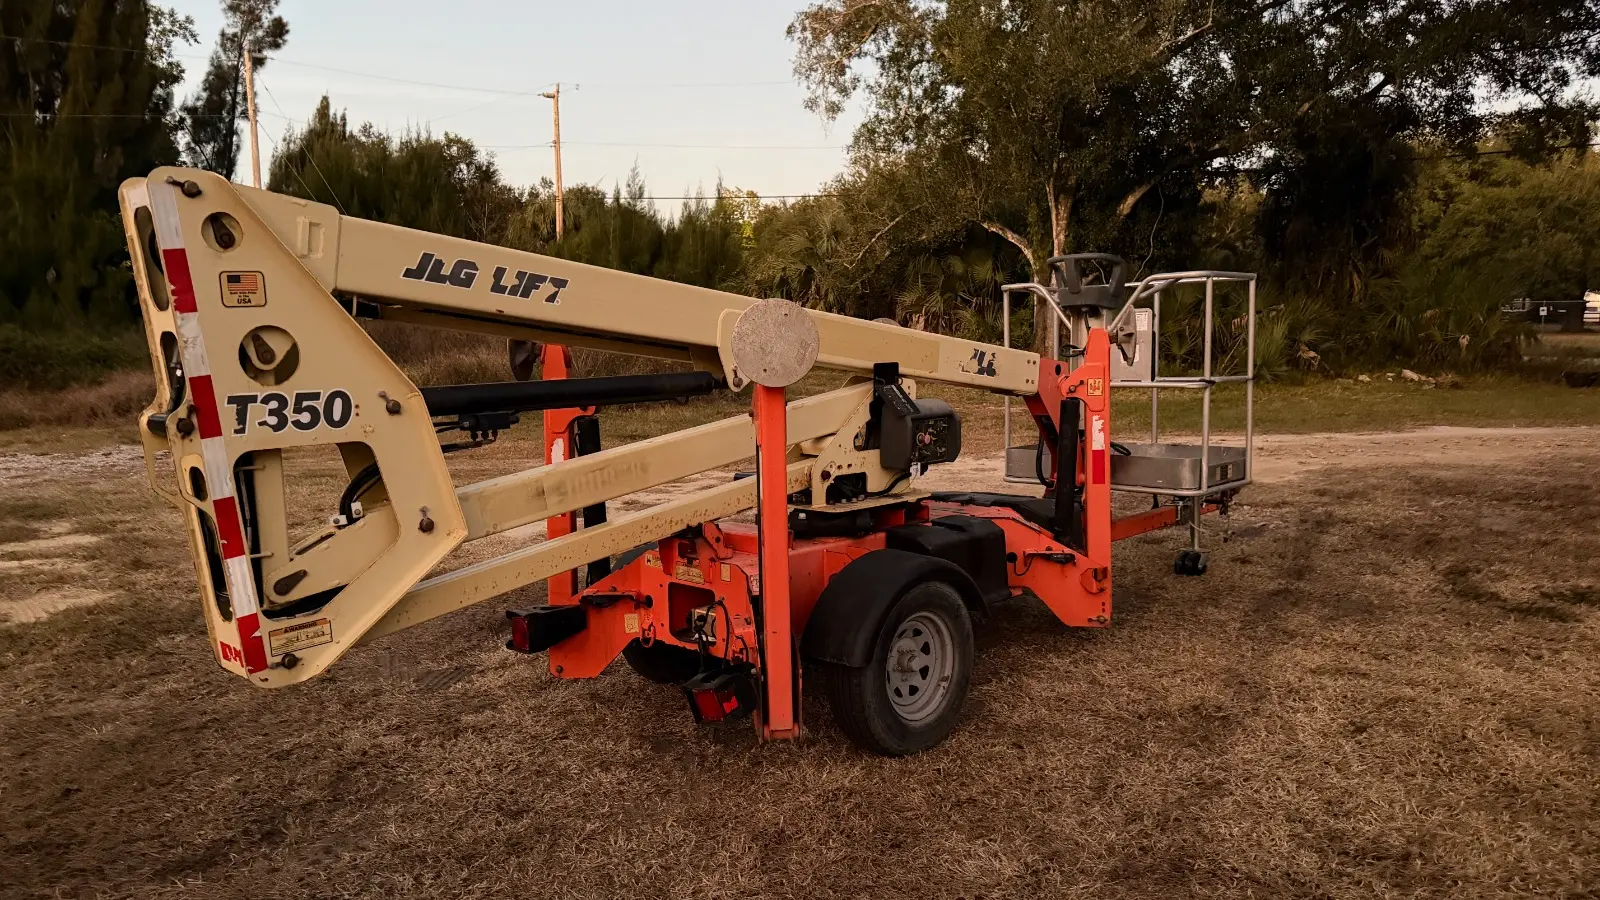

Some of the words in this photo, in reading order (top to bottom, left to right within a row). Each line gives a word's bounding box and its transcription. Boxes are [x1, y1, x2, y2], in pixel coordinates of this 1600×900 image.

[401, 251, 480, 289] JLG
[490, 266, 570, 304] LIFT
[225, 389, 353, 436] T350
